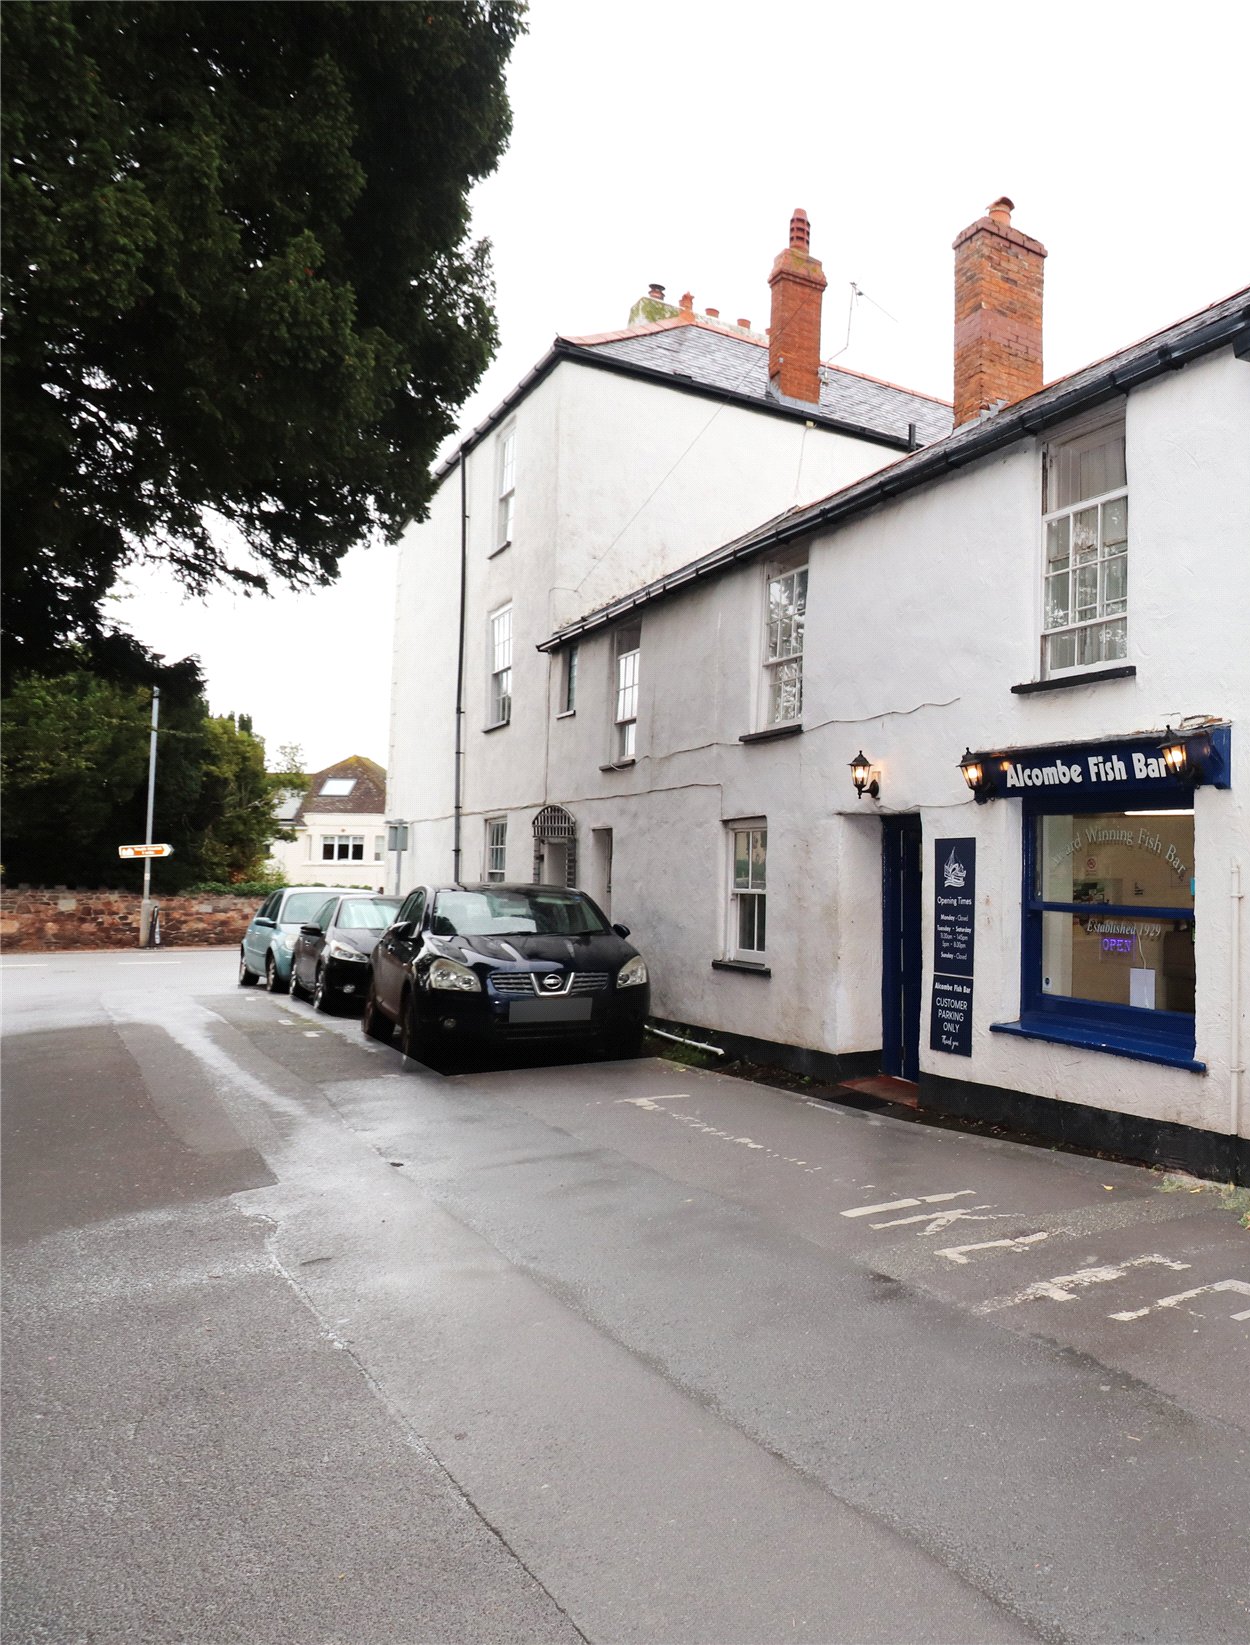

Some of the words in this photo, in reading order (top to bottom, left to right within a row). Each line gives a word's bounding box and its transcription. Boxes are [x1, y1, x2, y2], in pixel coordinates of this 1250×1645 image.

[1006, 759, 1082, 789] Alcombe
[1087, 754, 1127, 782] Fish
[1133, 752, 1167, 780] Bar
[1085, 825, 1134, 846] Winning
[1137, 827, 1162, 854] Fish
[1164, 844, 1188, 876] Bar
[937, 896, 957, 906] Opening
[958, 896, 972, 905] Times
[956, 926, 972, 934] Saturday
[1087, 919, 1137, 936] Established
[1139, 923, 1161, 937] 1929
[1102, 937, 1133, 952] OPEN
[941, 951, 954, 959] Sunday
[934, 982, 953, 991] Alcombe
[954, 984, 962, 992] Fish
[936, 997, 968, 1010] CUSTOMER
[938, 1009, 964, 1022] PARKING
[942, 1022, 960, 1033] ONLY
